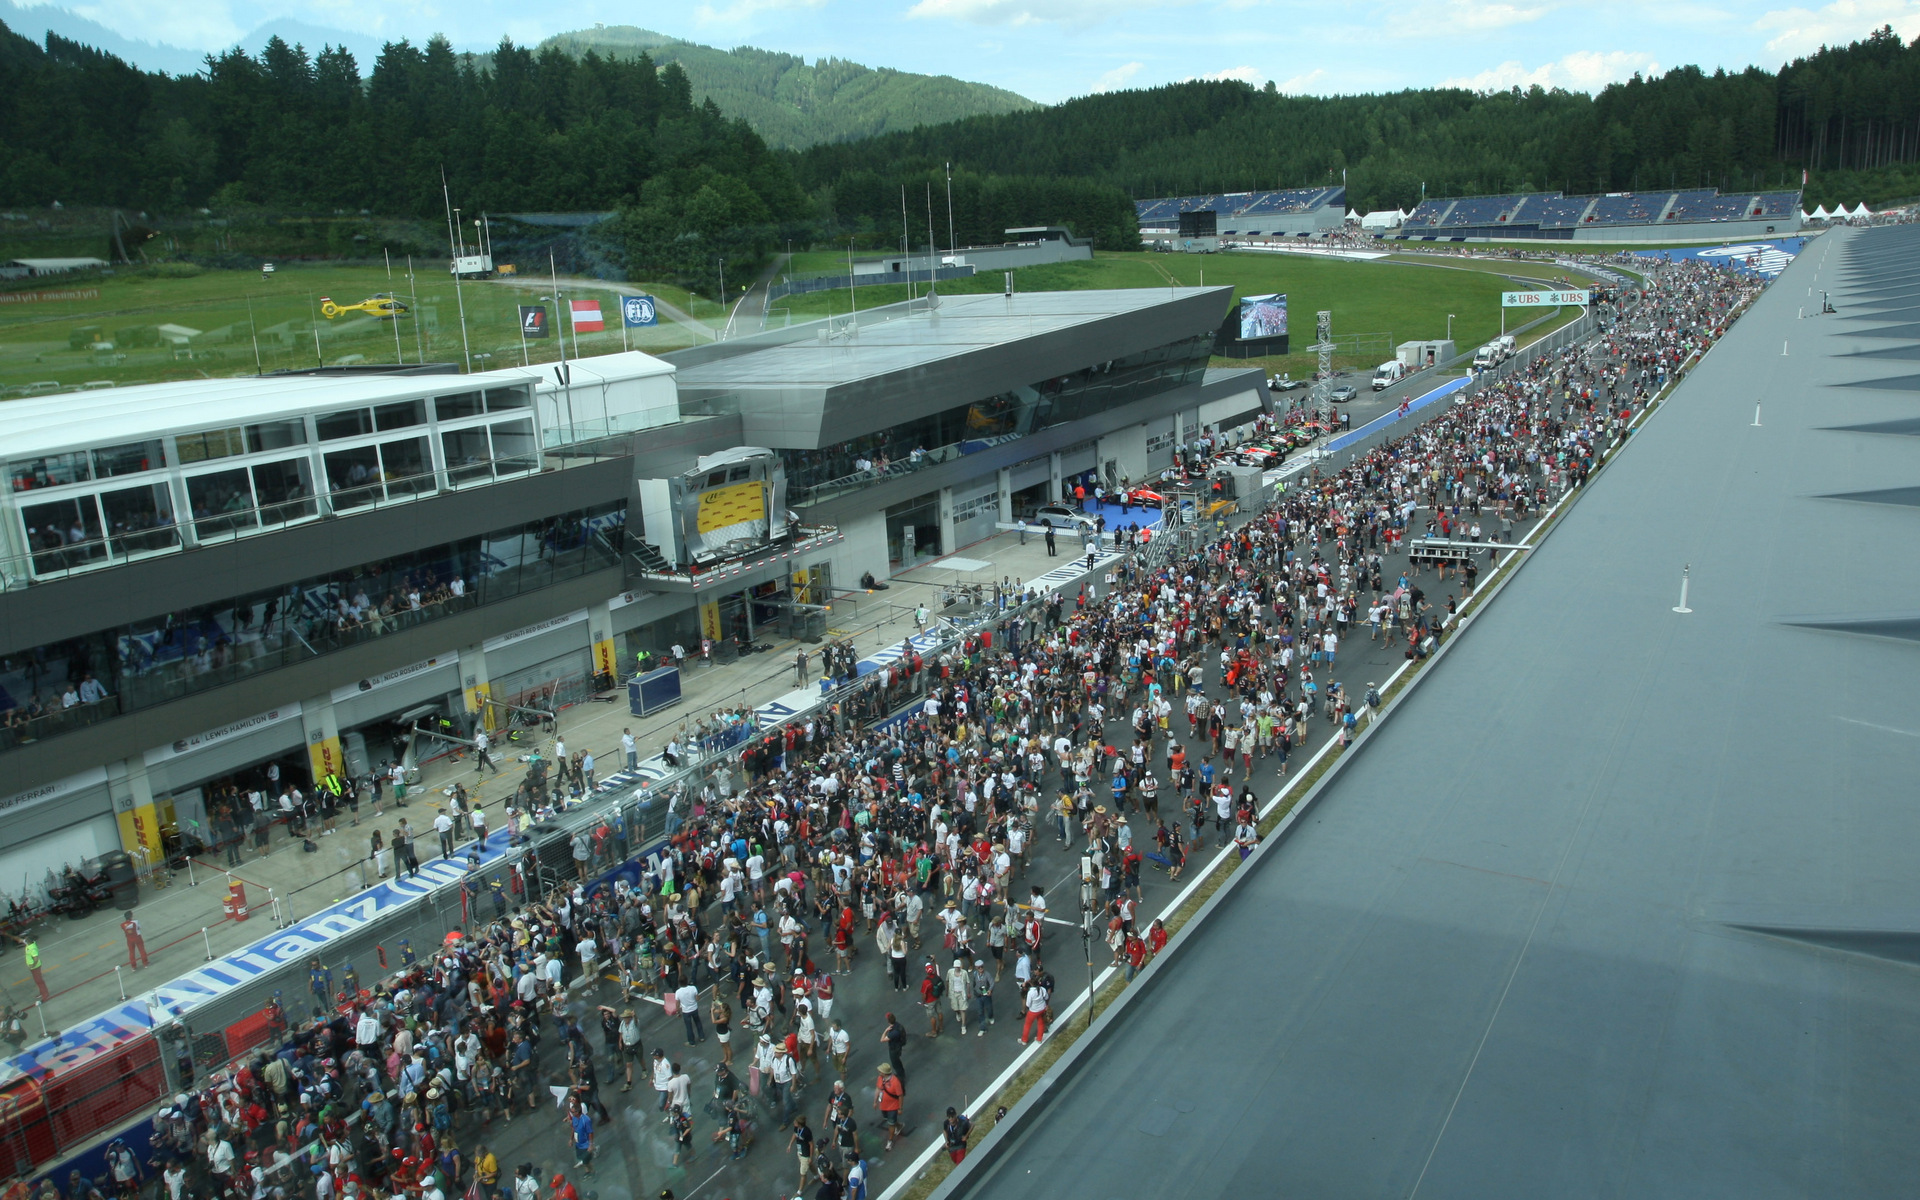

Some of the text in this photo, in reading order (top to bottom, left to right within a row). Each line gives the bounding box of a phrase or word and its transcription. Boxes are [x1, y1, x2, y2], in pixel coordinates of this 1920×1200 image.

[1518, 292, 1583, 304] UBS UBS
[525, 626, 537, 635] RED
[537, 621, 550, 631] BULL
[550, 615, 570, 626] RACING
[384, 671, 399, 682] NICO
[400, 661, 428, 676] ROSBERG
[205, 728, 229, 741] LEWIS
[230, 715, 267, 733] HAMILTON
[312, 731, 323, 741] 09
[16, 785, 56, 804] FERRARI
[121, 799, 132, 808] 10
[152, 897, 389, 1028] Allianz
